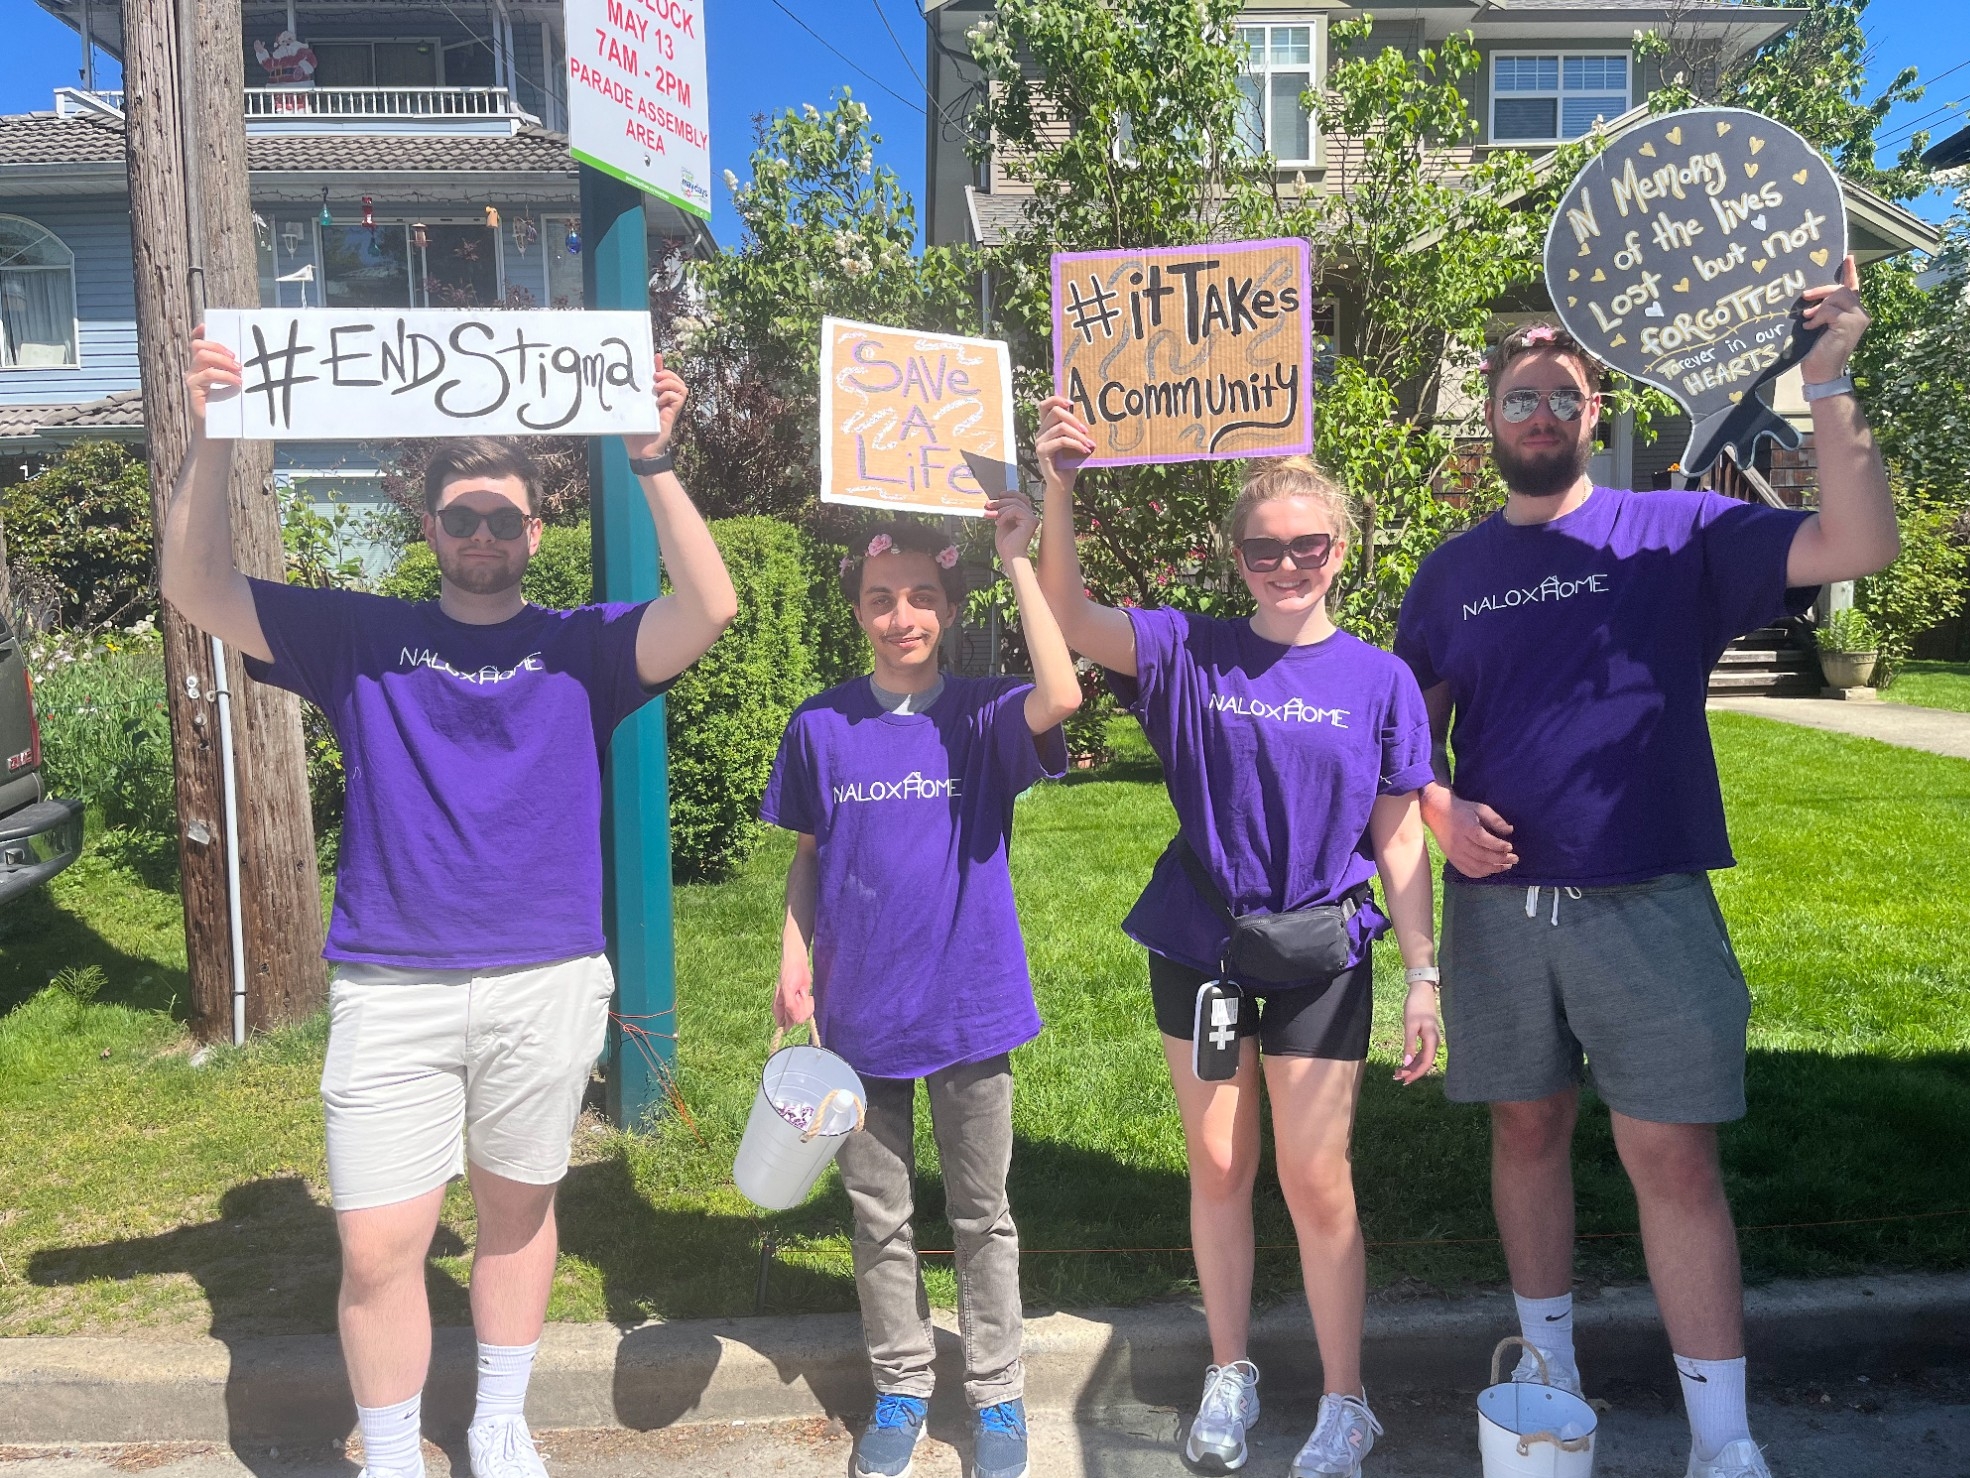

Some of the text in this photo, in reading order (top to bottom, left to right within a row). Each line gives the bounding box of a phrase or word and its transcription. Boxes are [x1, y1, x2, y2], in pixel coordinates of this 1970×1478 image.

[607, 0, 674, 61] MAY 13
[595, 28, 692, 109] 7AM - 2PM
[570, 57, 708, 151] PARADE ASSEMBLY
[626, 118, 665, 155] AREA
[1614, 181, 1784, 271] of the lives
[1588, 209, 1826, 333] Lost but not
[1725, 338, 1747, 353] in
[1755, 323, 1785, 343] our
[900, 404, 937, 443] A
[1068, 366, 1097, 425] A
